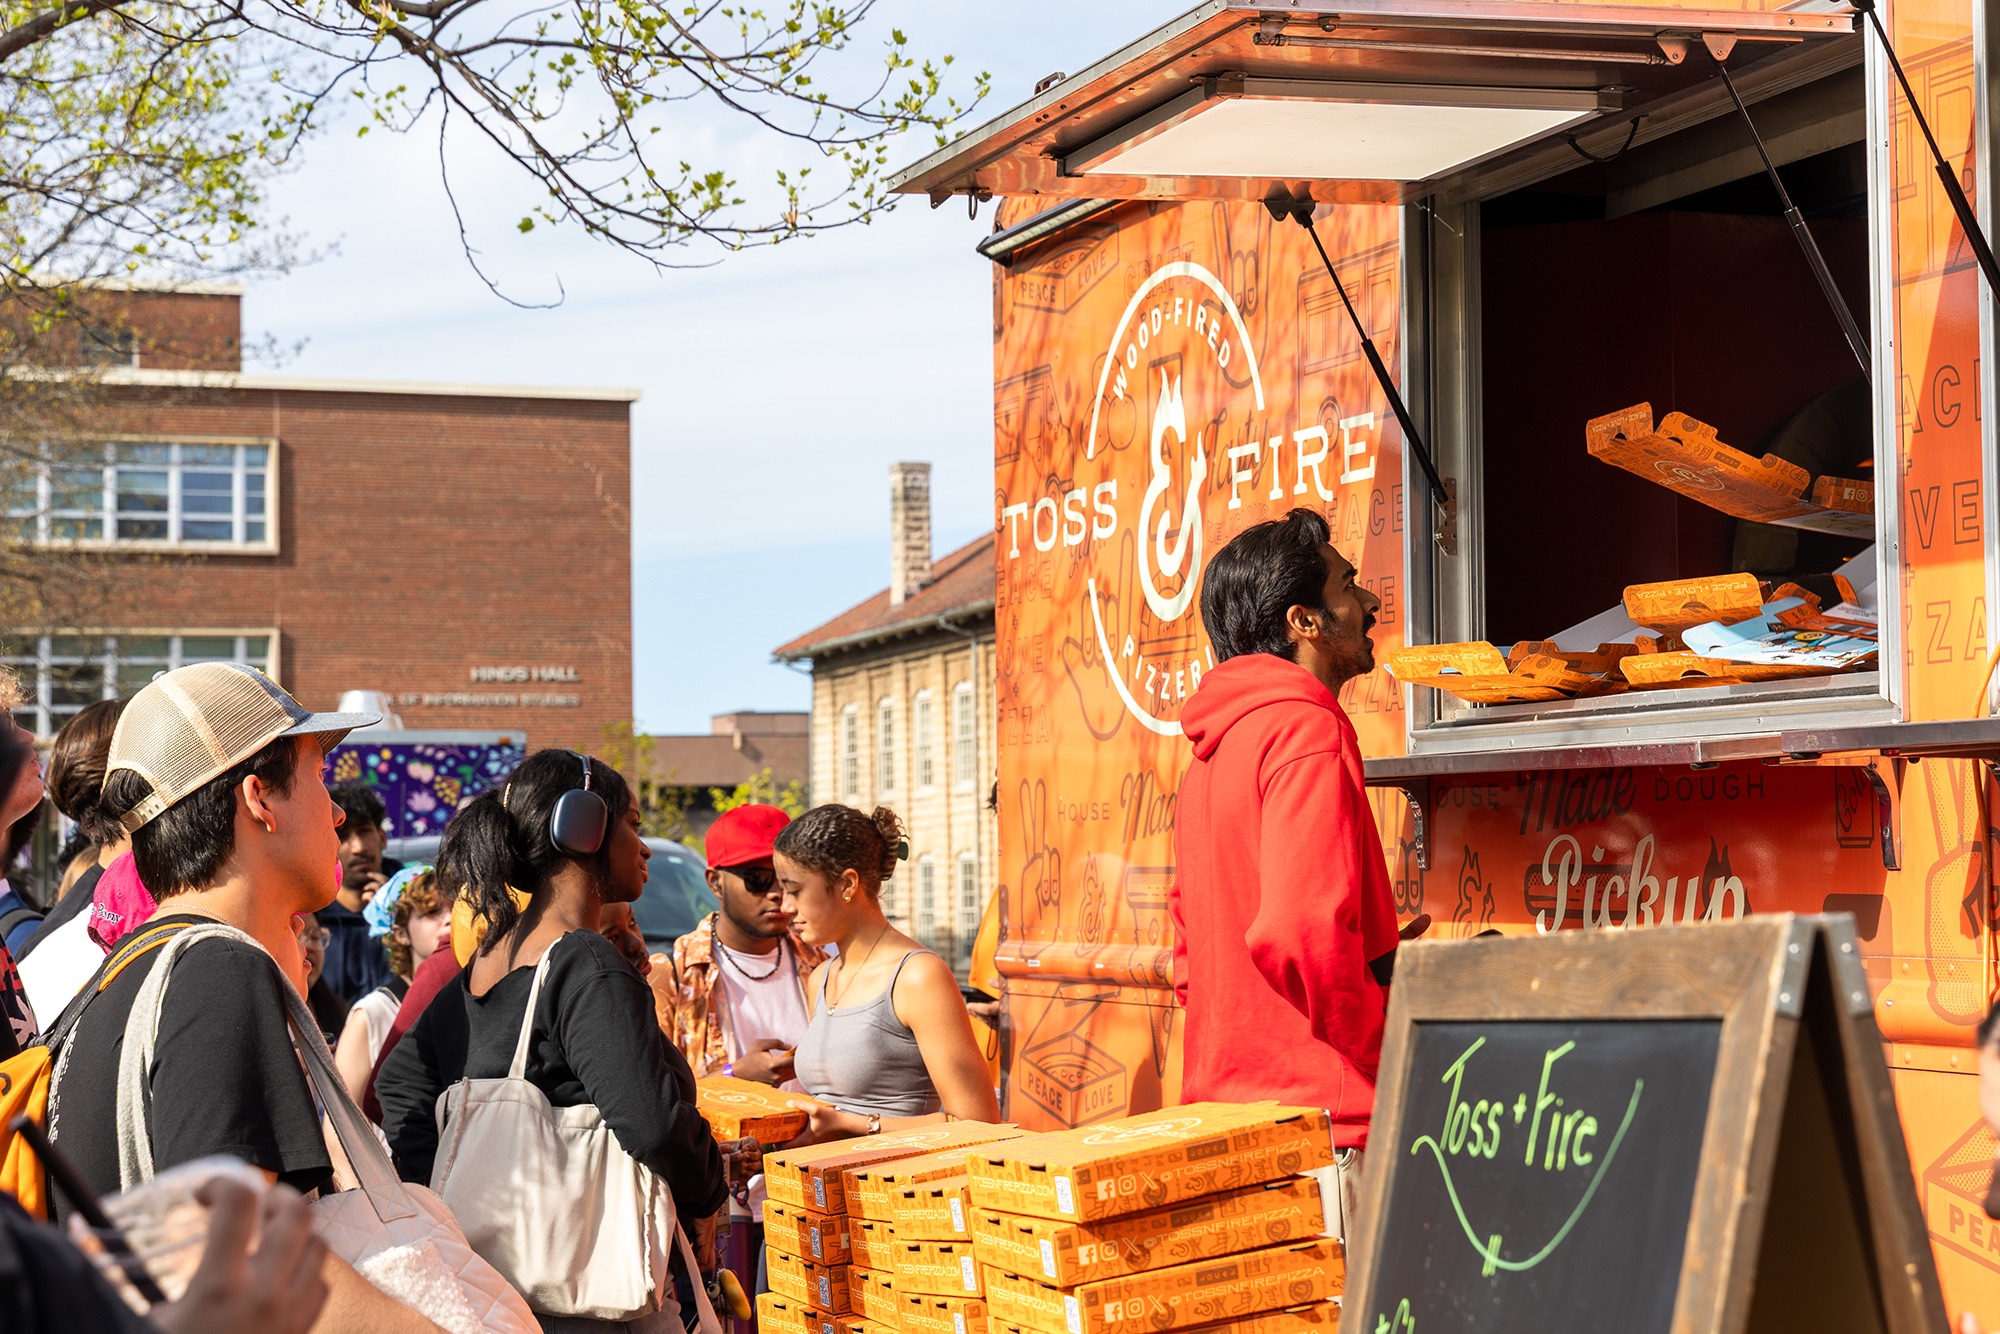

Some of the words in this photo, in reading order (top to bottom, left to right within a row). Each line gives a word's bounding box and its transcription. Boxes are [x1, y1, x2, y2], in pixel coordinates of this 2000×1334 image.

[1077, 248, 1107, 291] LOVE
[1021, 280, 1056, 303] PEACE
[1112, 297, 1231, 400] WOOD-FIRED
[1001, 478, 1118, 560] TOSS
[1226, 411, 1375, 511] FIRE
[1635, 589, 1665, 599] PIZZA
[1674, 585, 1702, 596] LOVE
[1712, 581, 1748, 591] PEACE
[470, 666, 529, 682] HINDS
[532, 666, 582, 682] HALL
[1121, 634, 1214, 701] PIZZERI
[1396, 655, 1422, 663] PIZZA
[1461, 652, 1492, 661] PEACE
[1057, 802, 1110, 822] HOUSE
[1120, 769, 1185, 844] Mad
[1434, 783, 1499, 810] OUSE
[1516, 765, 1637, 836] Made
[1653, 773, 1764, 803] DOUGH
[1534, 832, 1747, 936] Pickup
[1027, 1070, 1063, 1112] PEACE
[1084, 1083, 1114, 1113] LOVE
[1441, 1035, 1505, 1160] Toss
[1524, 1039, 1599, 1172] Fire
[1159, 1137, 1312, 1183] @TOSSNFIREPIZZA
[1143, 1205, 1302, 1249] @TOSSNFIREPIZZA
[1168, 1266, 1326, 1306] @TOSSNFIREPIZZA
